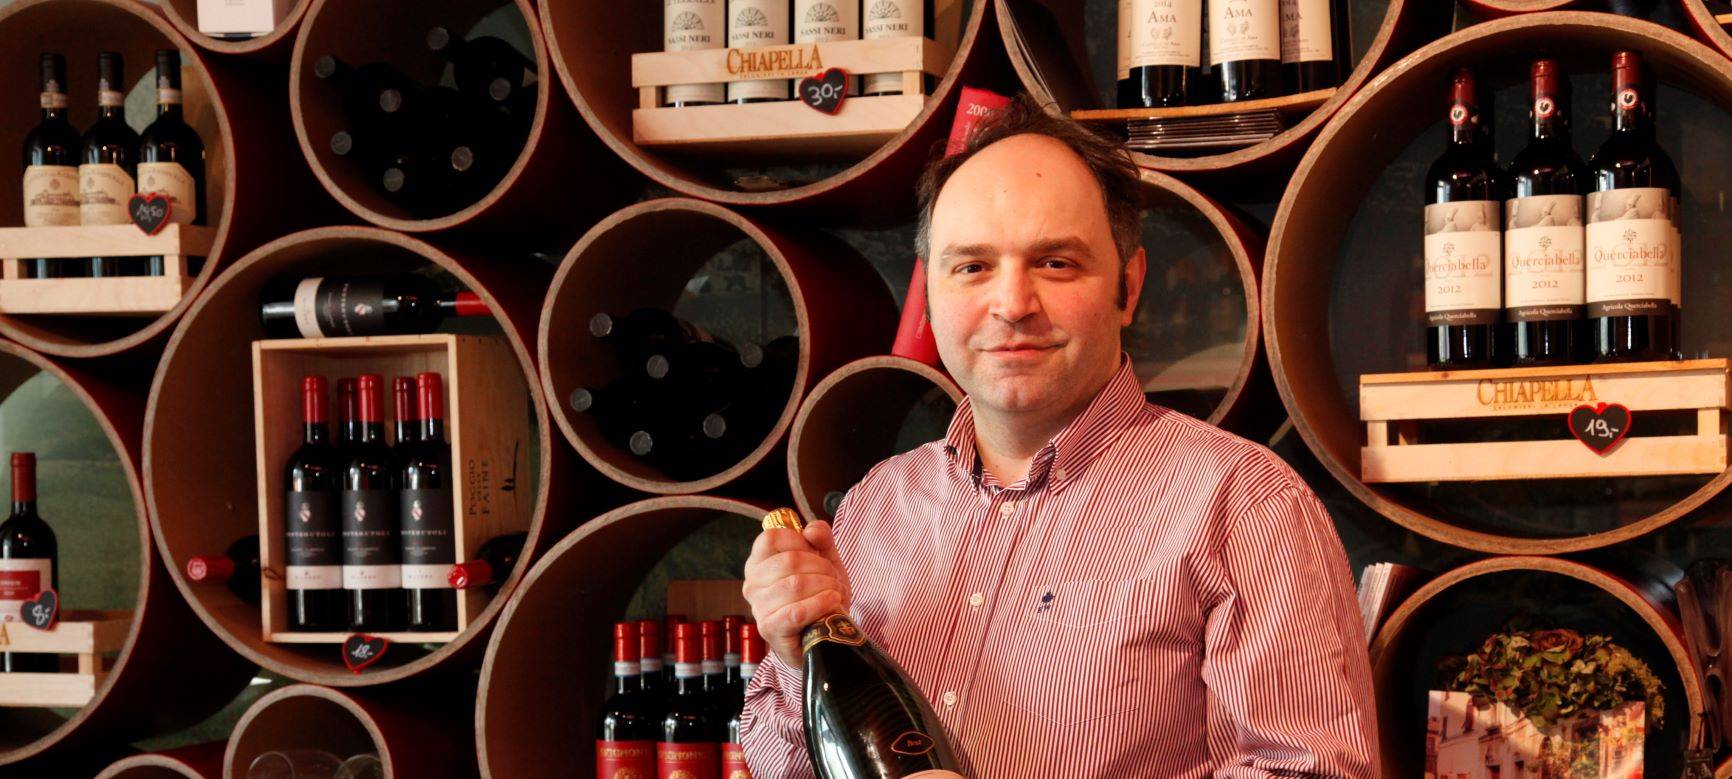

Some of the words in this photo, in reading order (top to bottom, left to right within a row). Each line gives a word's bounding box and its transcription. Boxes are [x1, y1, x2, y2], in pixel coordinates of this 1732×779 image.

[824, 26, 846, 35] NERI
[886, 23, 908, 31] NERI
[689, 35, 711, 43] NERI
[752, 31, 775, 39] NERI
[726, 44, 823, 75] CHIAPELLA
[1594, 245, 1665, 263] Querciabella
[1510, 250, 1582, 269] Querciabella
[1616, 273, 1644, 283] 2012
[1532, 280, 1559, 289] 2012
[1437, 285, 1462, 295] 2012
[1477, 374, 1598, 405] CHIAPELLA
